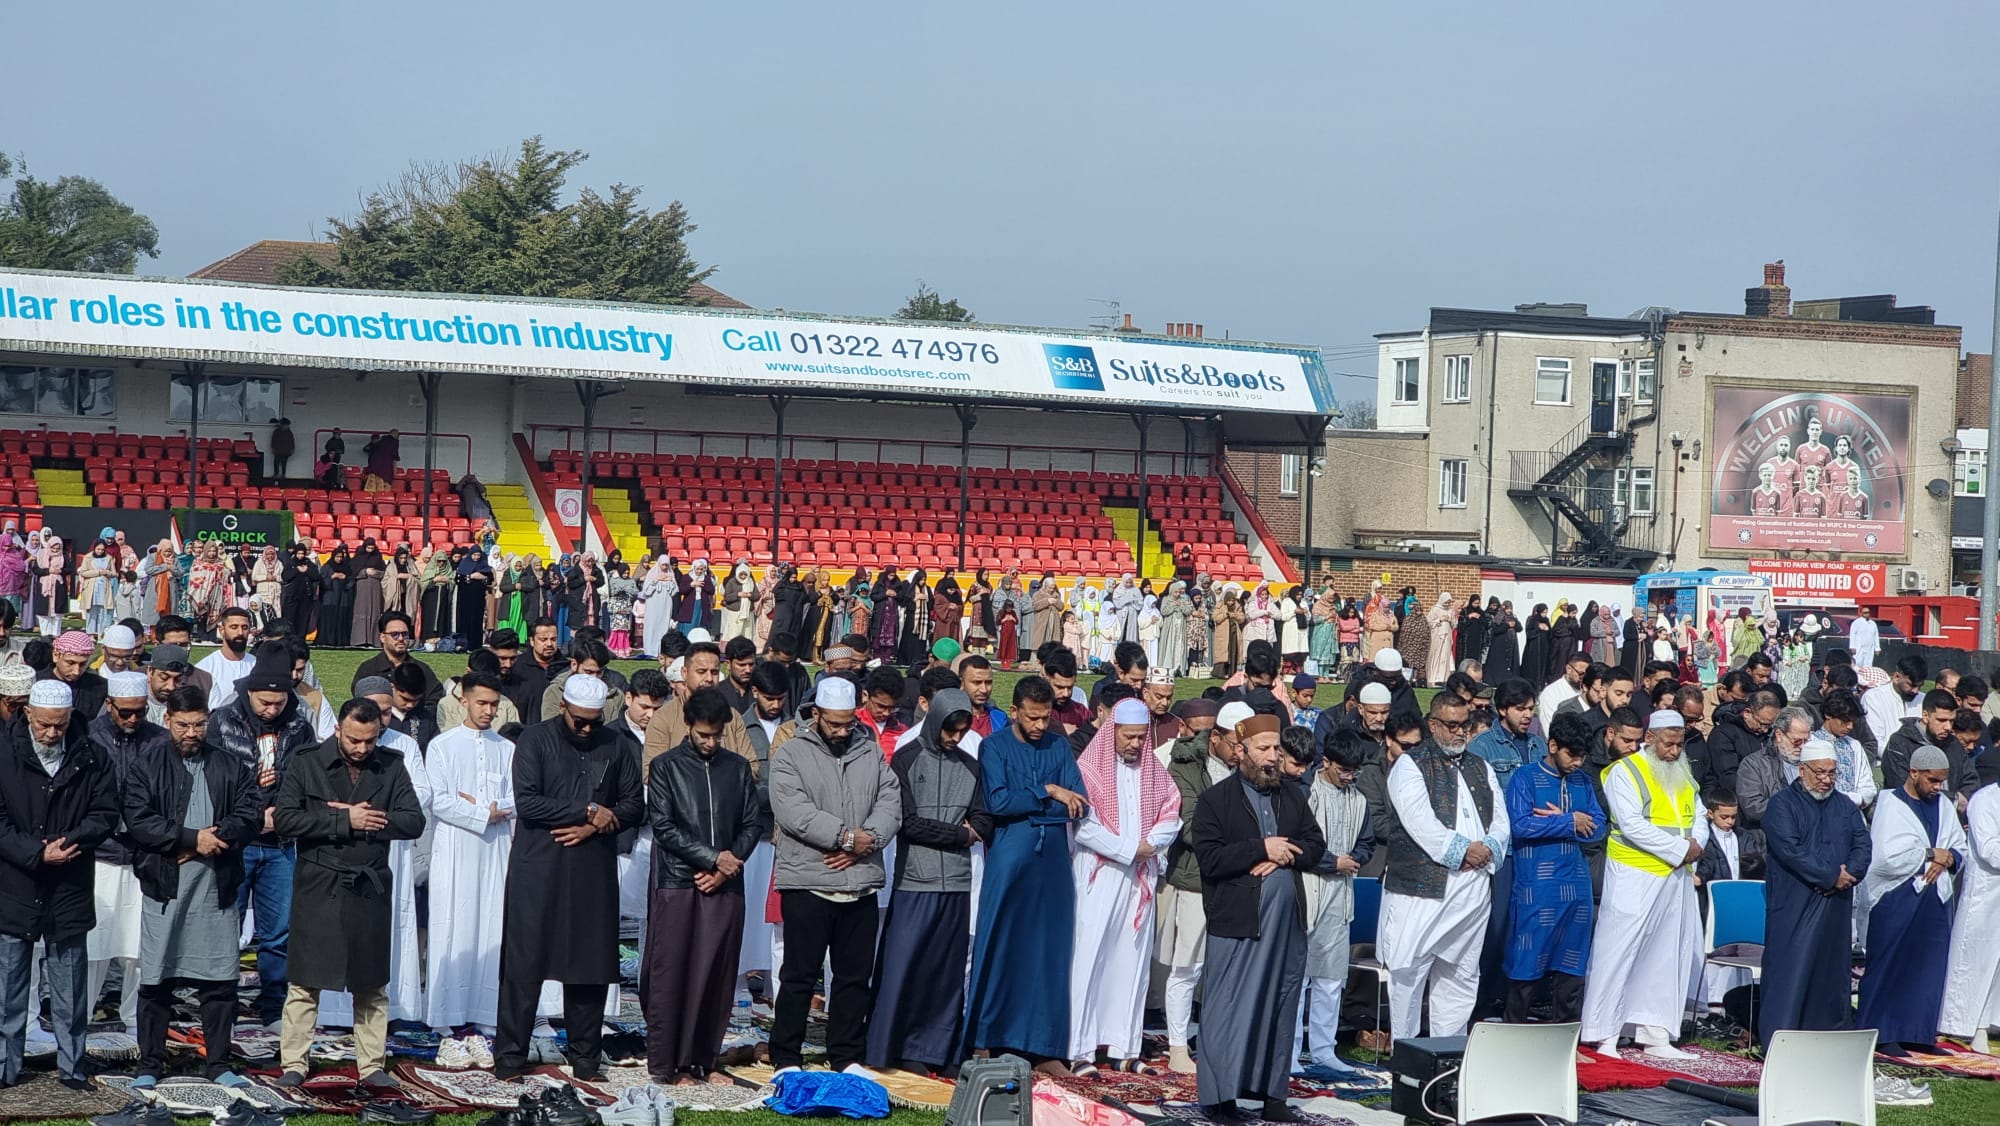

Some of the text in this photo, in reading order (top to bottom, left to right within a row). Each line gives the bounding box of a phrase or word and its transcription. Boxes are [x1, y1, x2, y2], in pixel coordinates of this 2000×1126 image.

[70, 297, 165, 328] roles
[176, 298, 211, 330] in
[219, 302, 282, 334] the
[293, 311, 521, 347] construction
[531, 319, 673, 362] industry
[721, 328, 1000, 365] Call 01322 474976
[765, 361, 972, 383] www.suitsandbootsrec.com
[1051, 356, 1094, 372] S&B
[1109, 358, 1286, 393] Suits&Boots
[1159, 385, 1264, 401] Careers to suit you
[1730, 403, 1821, 475] WELLING
[197, 530, 267, 543] CARRICK
[1750, 560, 1782, 568] WELCOME
[1808, 573, 1852, 590] UNITED
